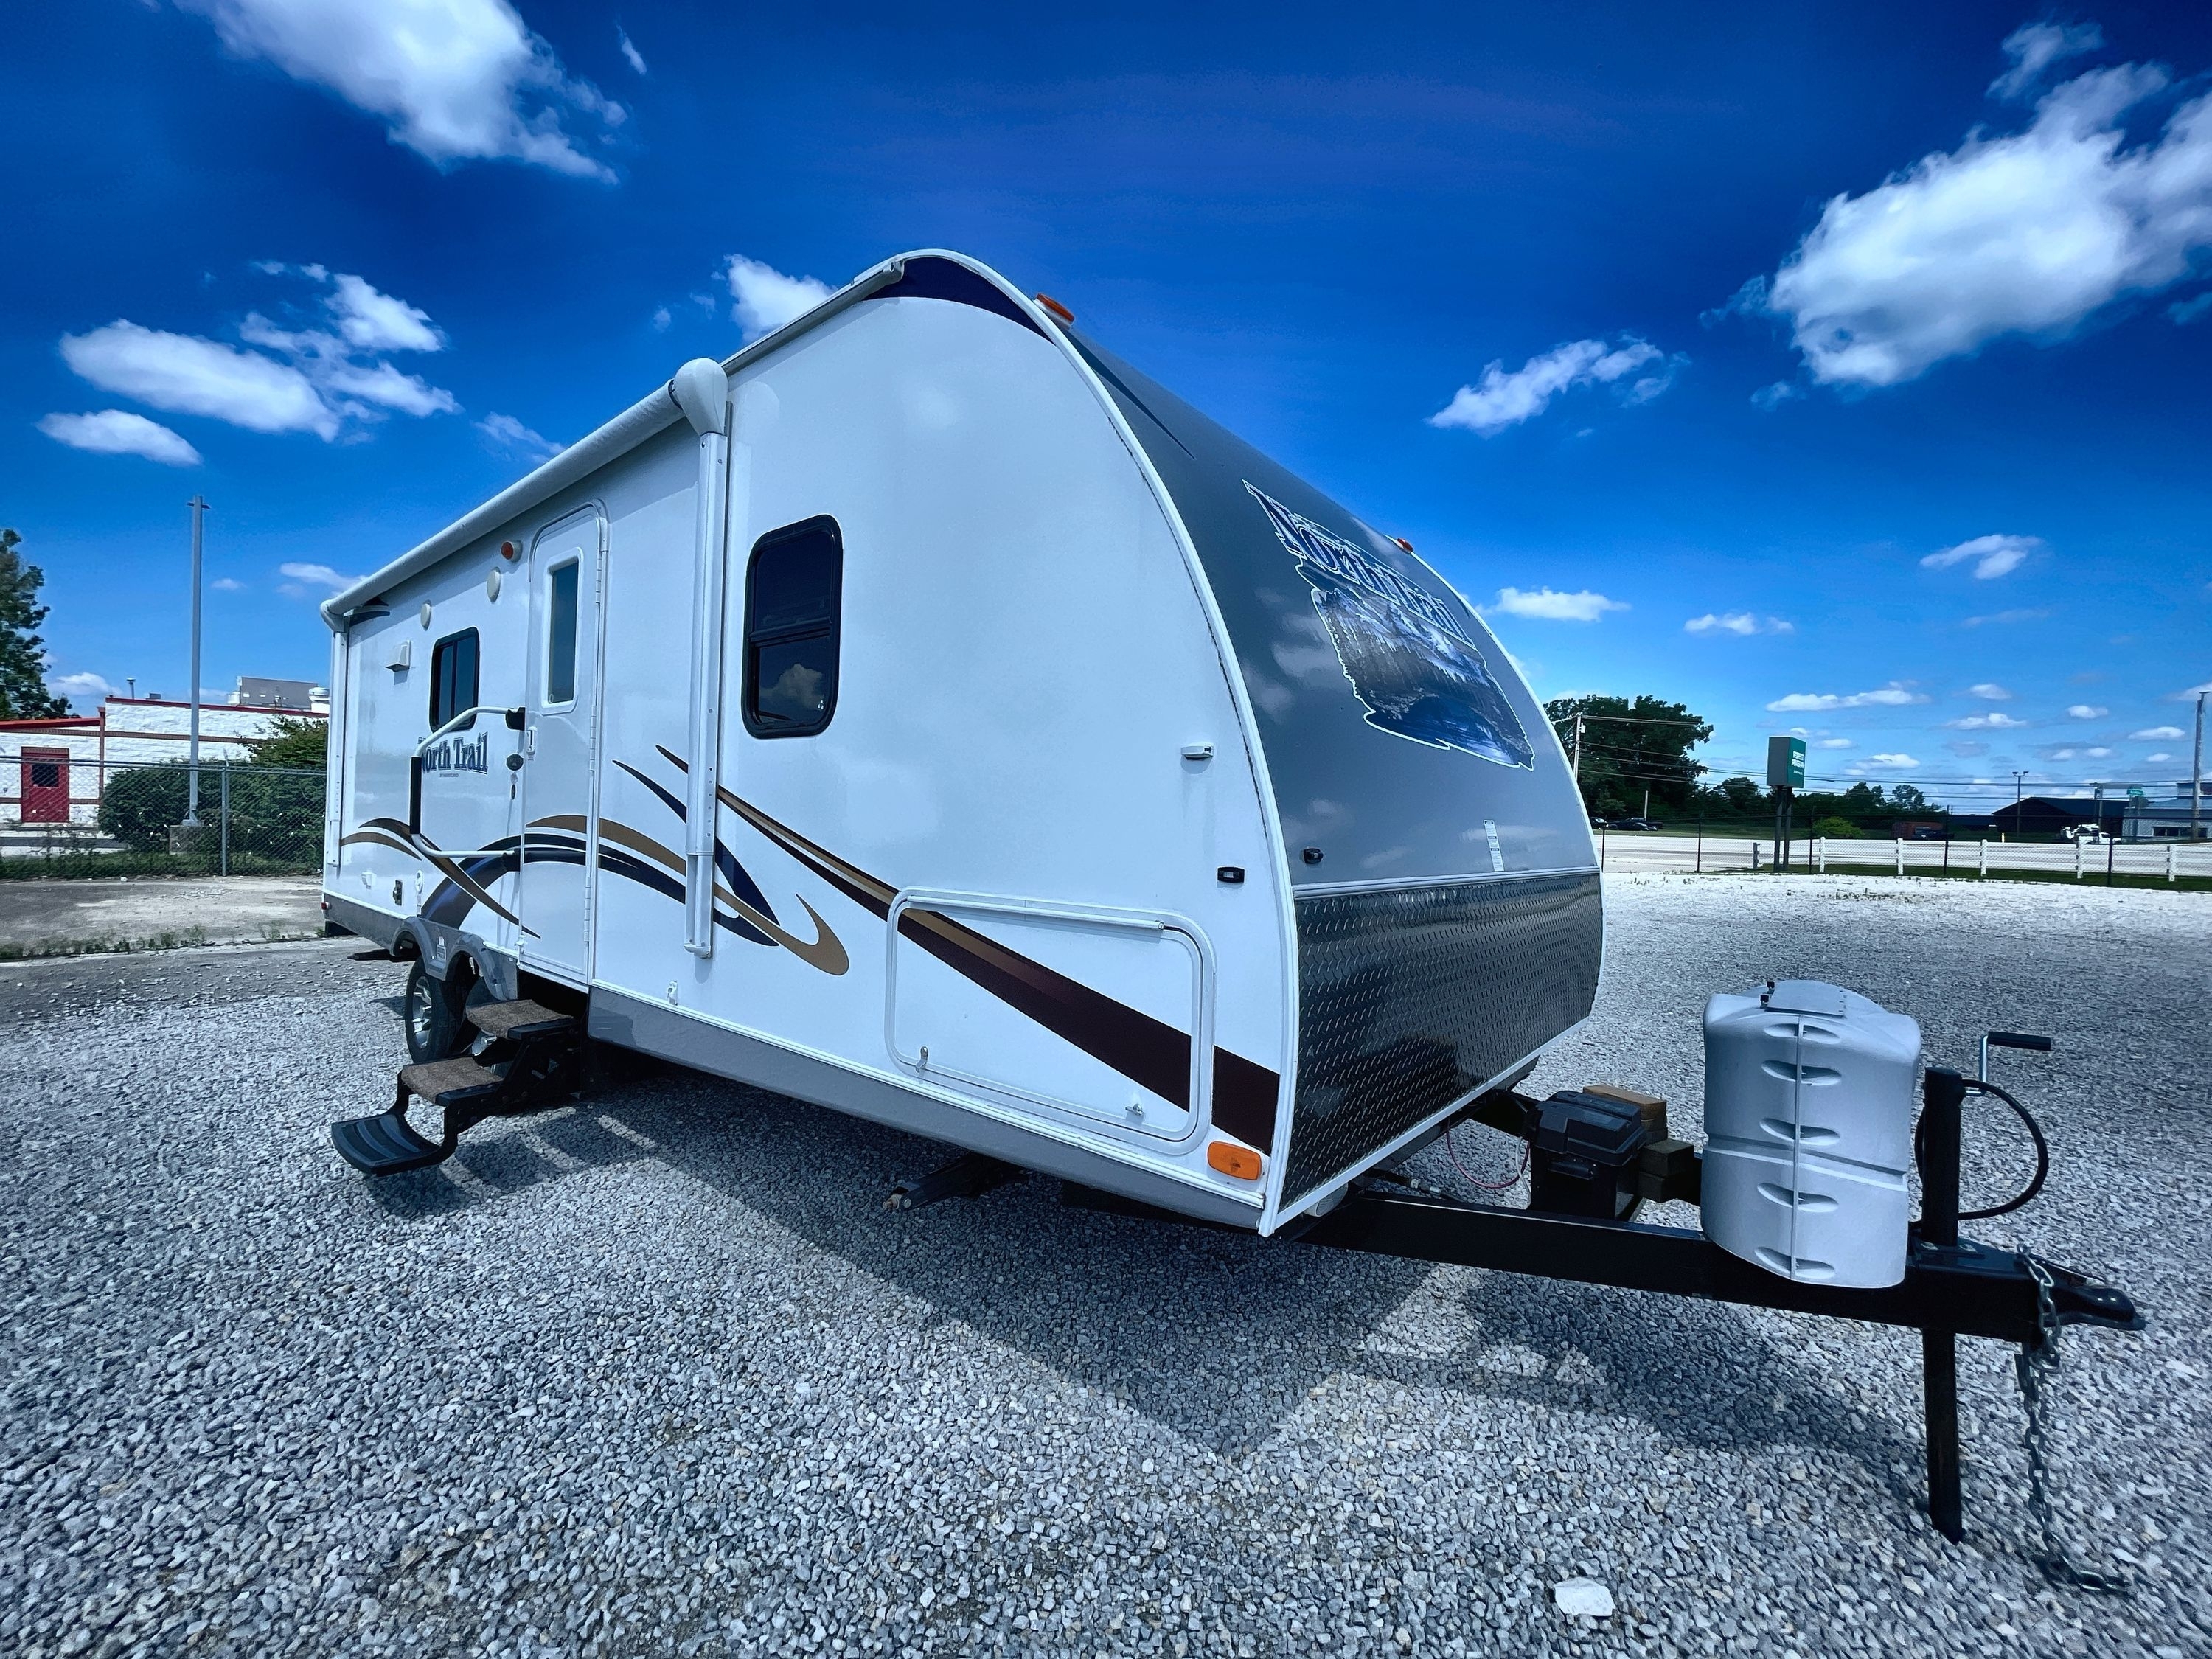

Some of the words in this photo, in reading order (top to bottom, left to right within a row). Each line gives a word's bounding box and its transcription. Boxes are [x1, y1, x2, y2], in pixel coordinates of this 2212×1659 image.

[1242, 479, 1401, 606] North
[1374, 563, 1476, 650] Trail
[453, 731, 488, 775] Trail
